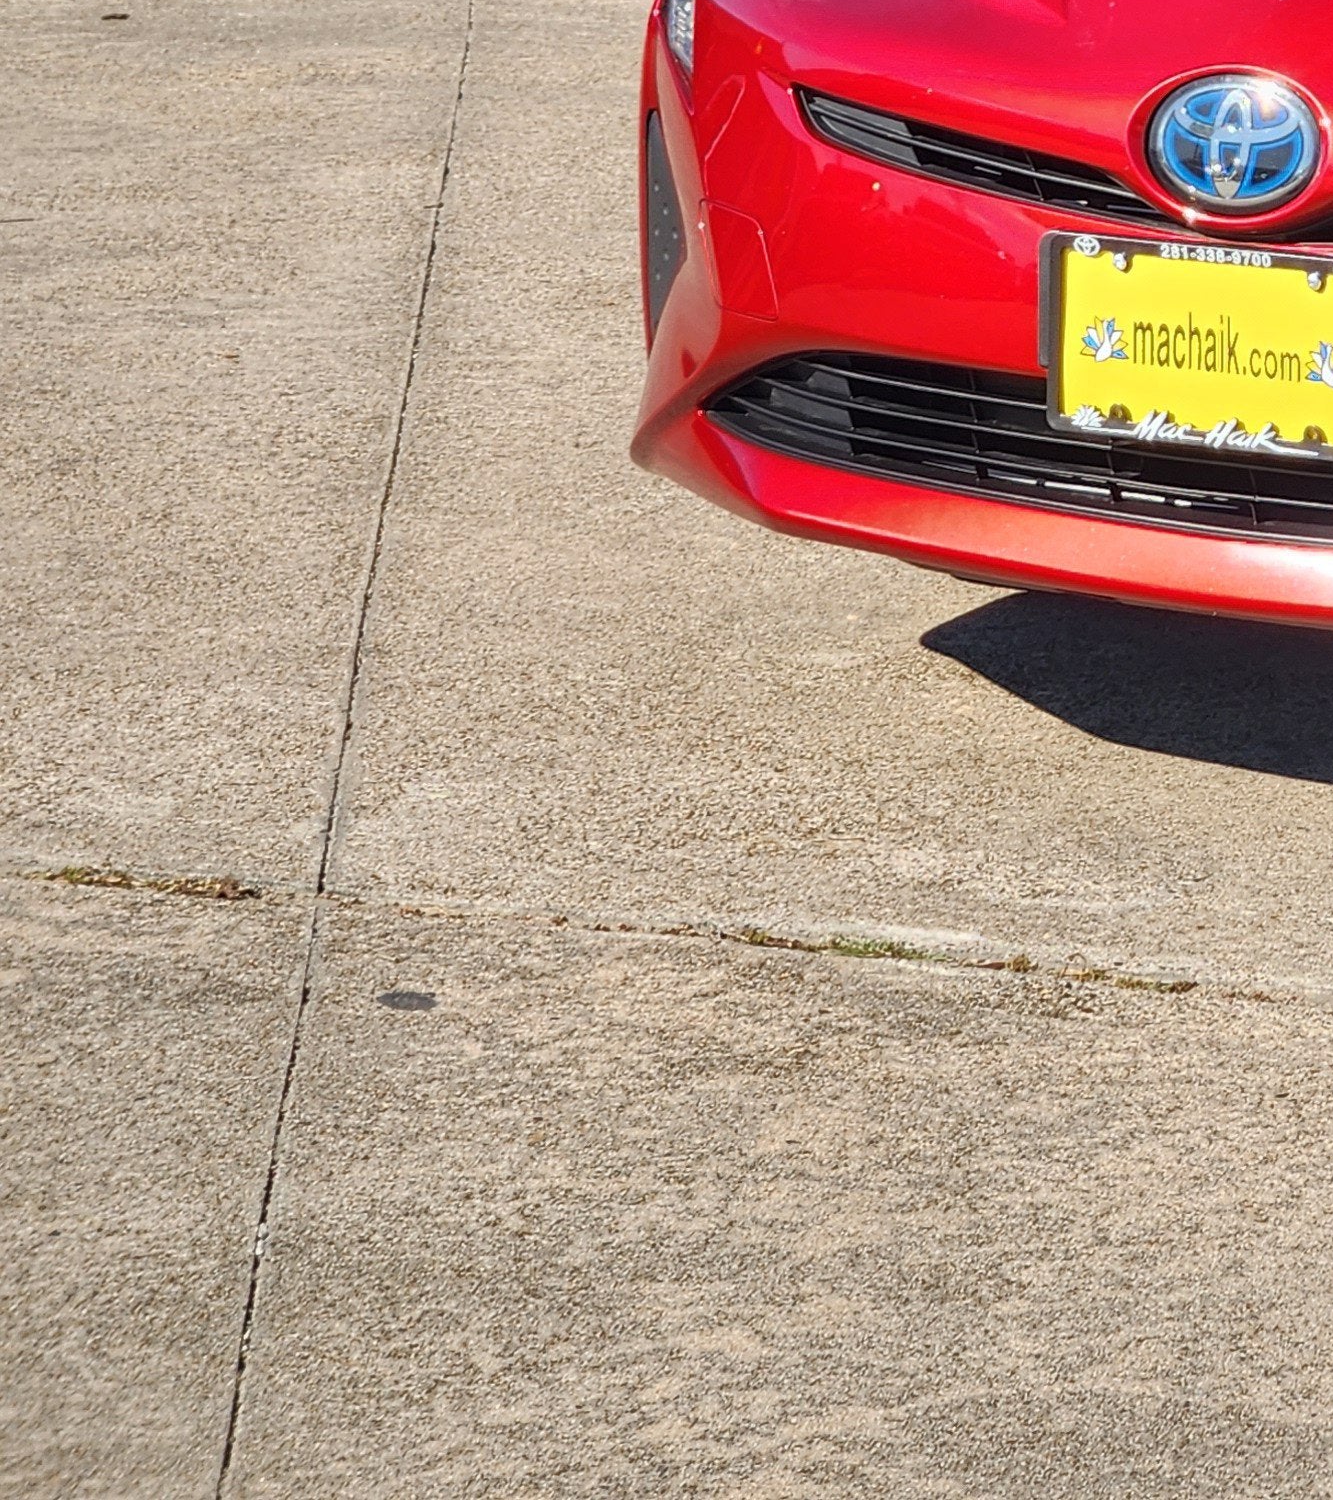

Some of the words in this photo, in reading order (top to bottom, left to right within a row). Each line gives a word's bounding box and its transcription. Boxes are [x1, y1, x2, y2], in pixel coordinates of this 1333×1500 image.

[1132, 311, 1302, 383] machaik.com
[1132, 408, 1196, 442] Mac
[1202, 417, 1300, 456] Haik
